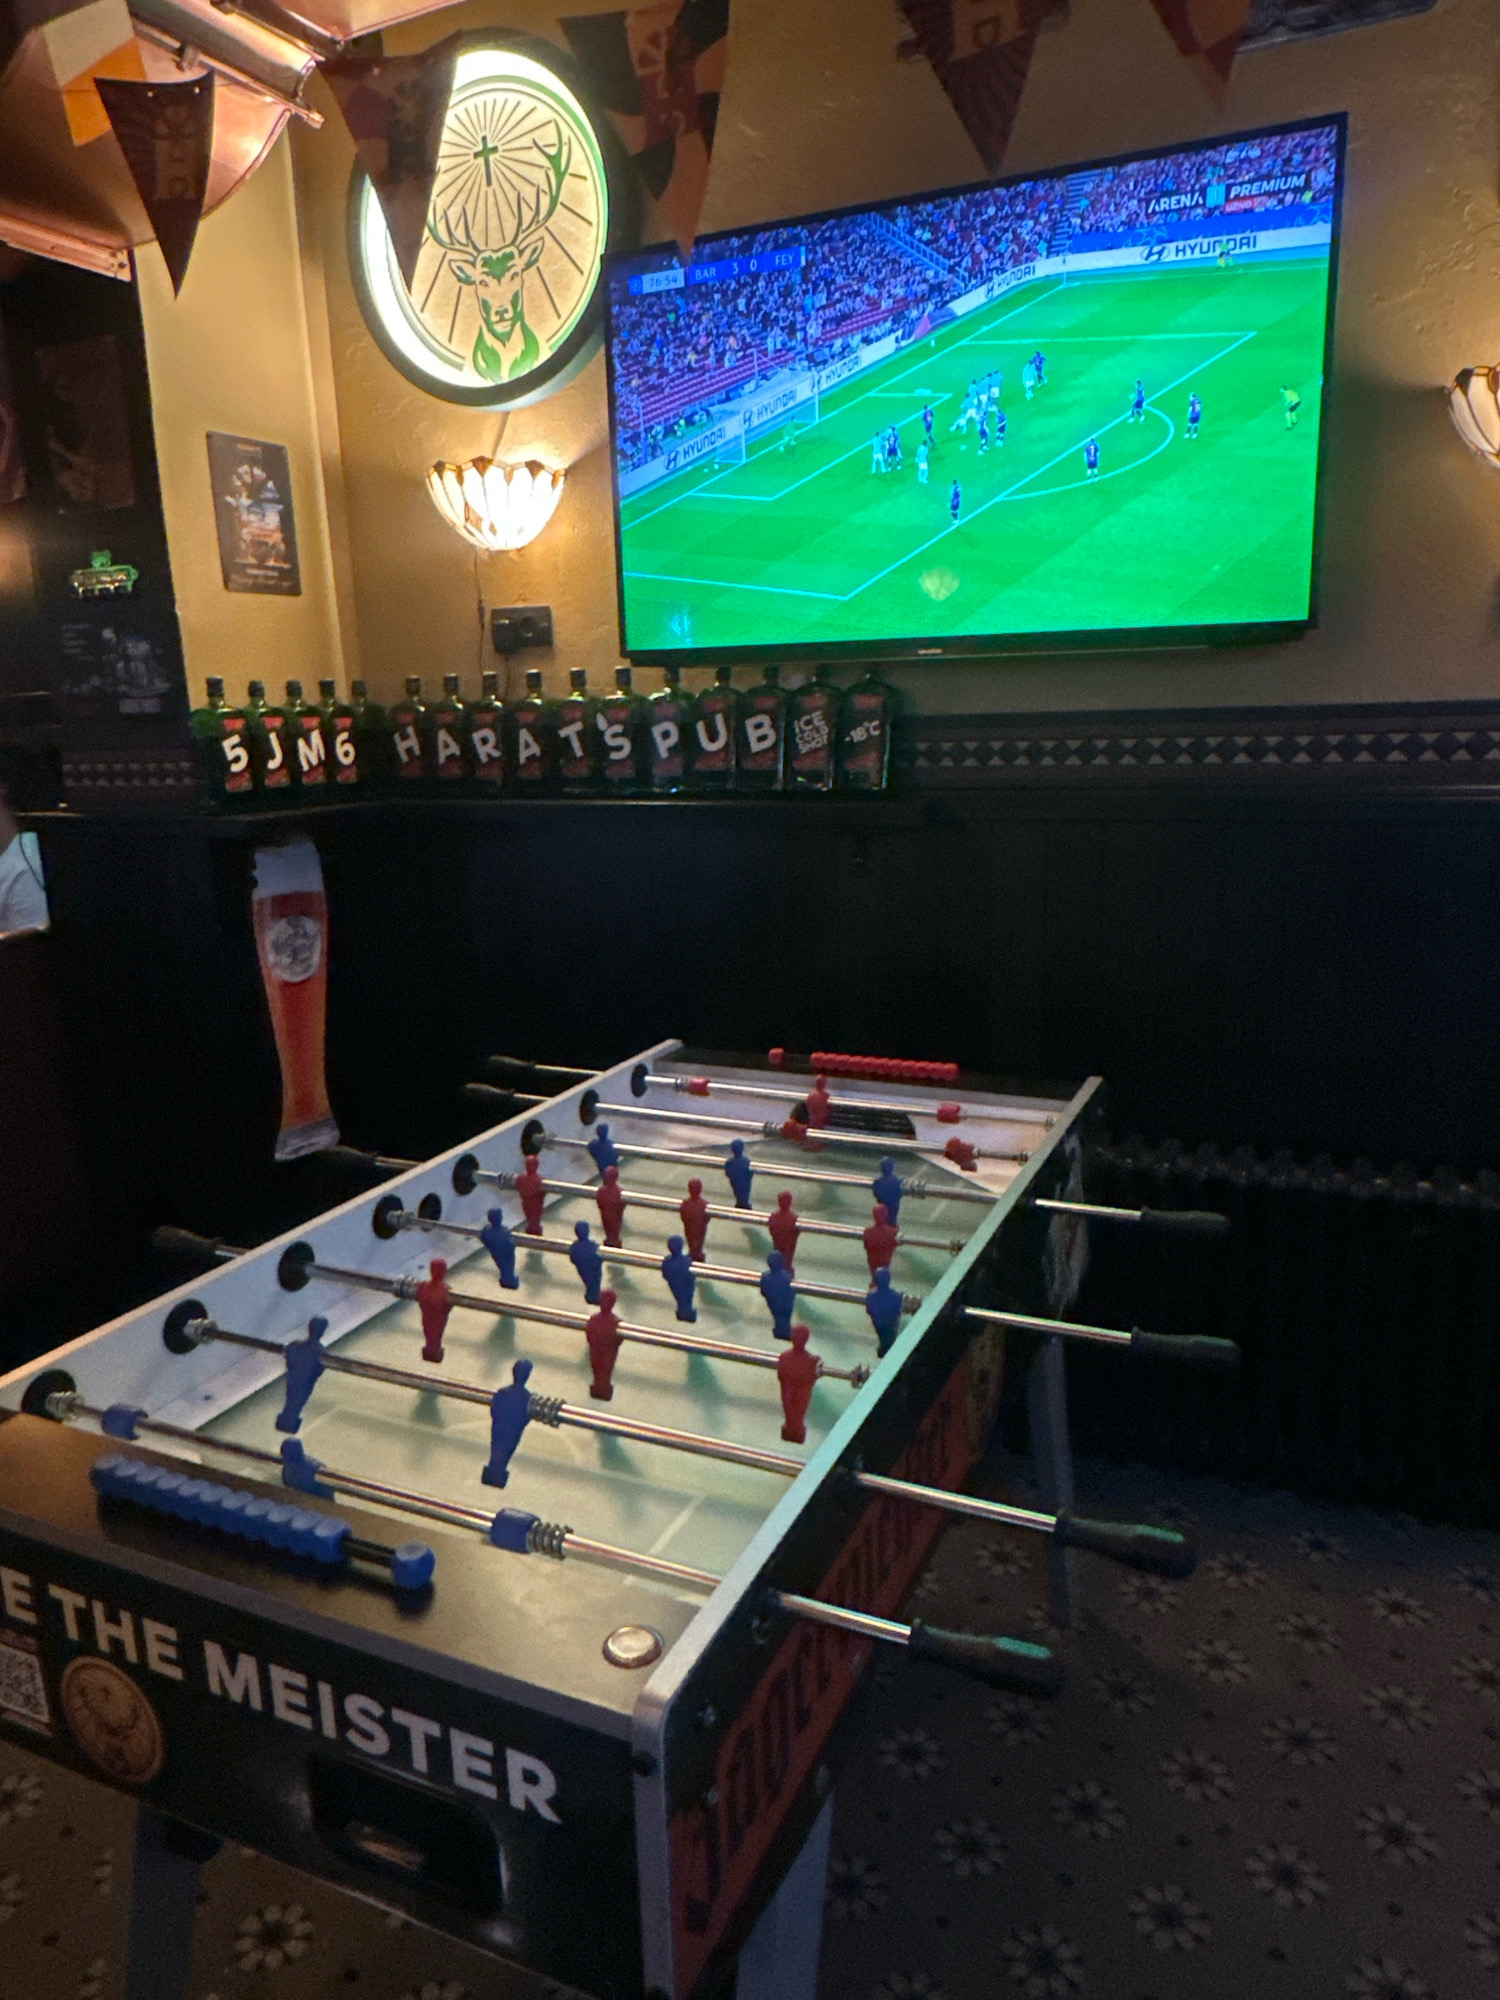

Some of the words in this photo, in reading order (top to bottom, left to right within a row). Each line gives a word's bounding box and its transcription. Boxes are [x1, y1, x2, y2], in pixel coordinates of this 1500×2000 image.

[1148, 192, 1204, 213] ARENA
[1229, 174, 1306, 199] PREMIUM
[695, 267, 716, 281] BAR
[732, 262, 739, 274] 3
[750, 259, 757, 271] 0
[775, 253, 795, 266] FEY
[756, 389, 797, 419] HYUNDAI
[683, 426, 726, 460] HYUNDAI
[794, 711, 824, 733] ICE
[48, 1583, 184, 1680] THE
[203, 1639, 563, 1825] MEISTER
